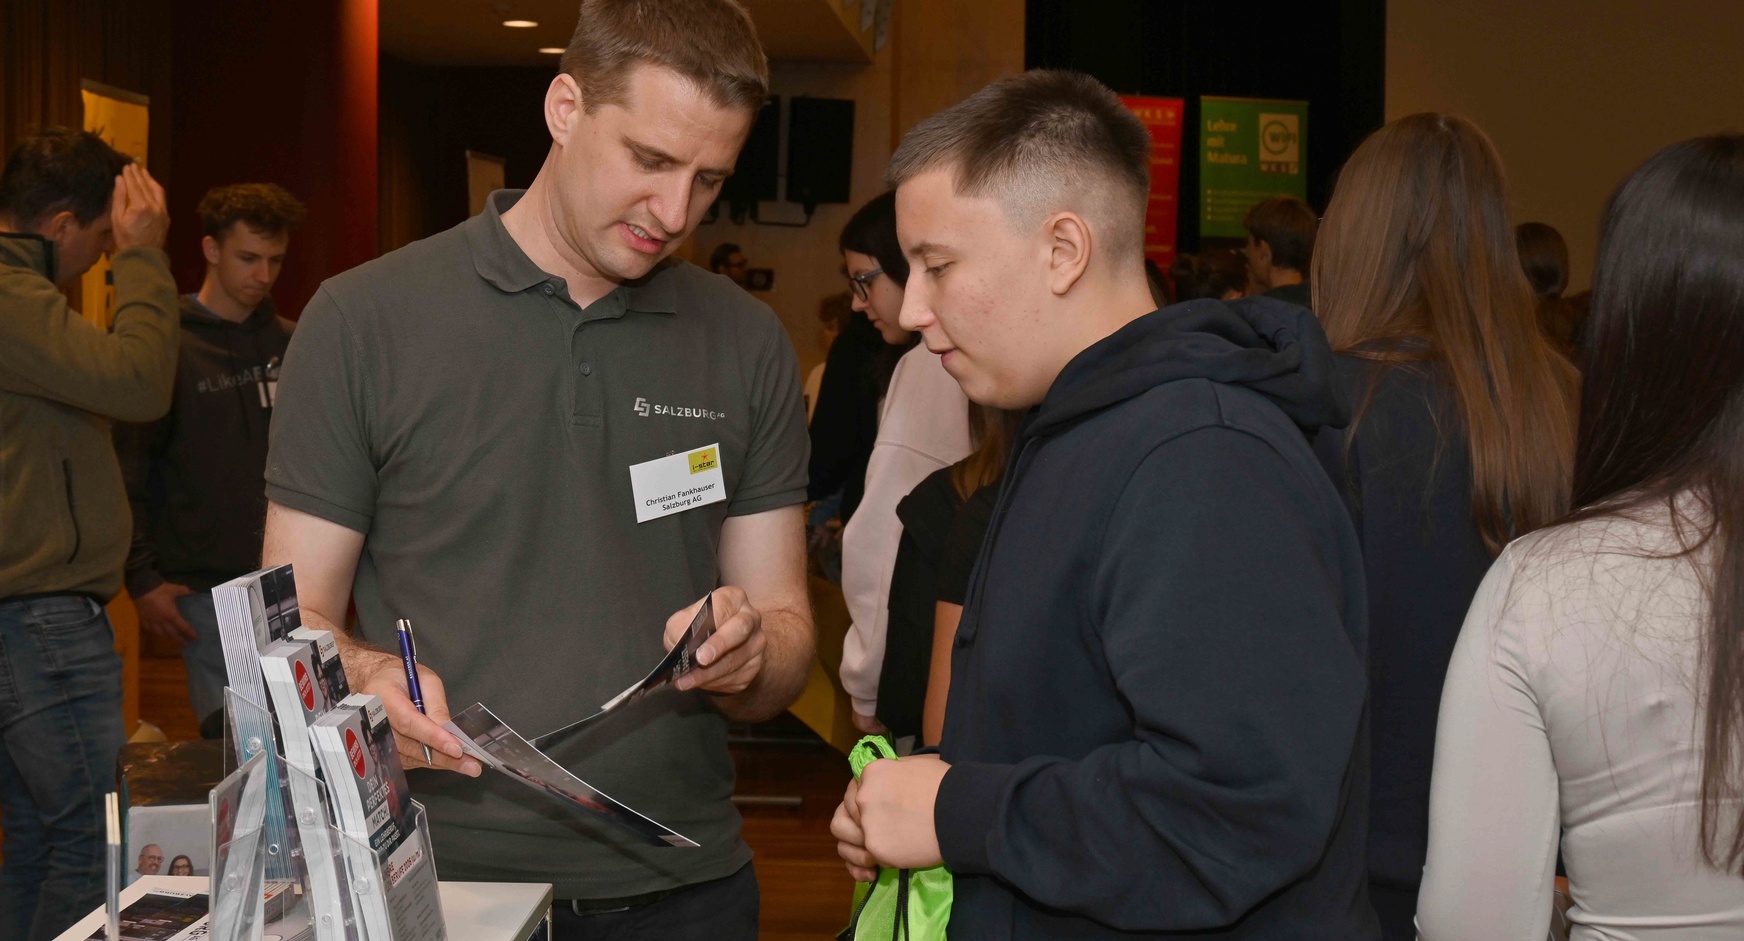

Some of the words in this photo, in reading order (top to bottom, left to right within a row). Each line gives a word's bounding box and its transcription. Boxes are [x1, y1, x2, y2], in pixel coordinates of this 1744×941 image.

[1207, 117, 1237, 132] Lehre
[1207, 135, 1226, 147] mit
[1207, 151, 1248, 164] Matura
[654, 404, 717, 420] SALZBURG
[692, 459, 715, 471] i-star
[645, 493, 676, 507] Christian
[677, 482, 716, 498] Fankhauser
[662, 498, 691, 511] Salzburg
[692, 494, 702, 503] AG
[366, 775, 379, 793] DEIN
[366, 781, 391, 810] PERFEKTES
[371, 808, 389, 827] MATCH!
